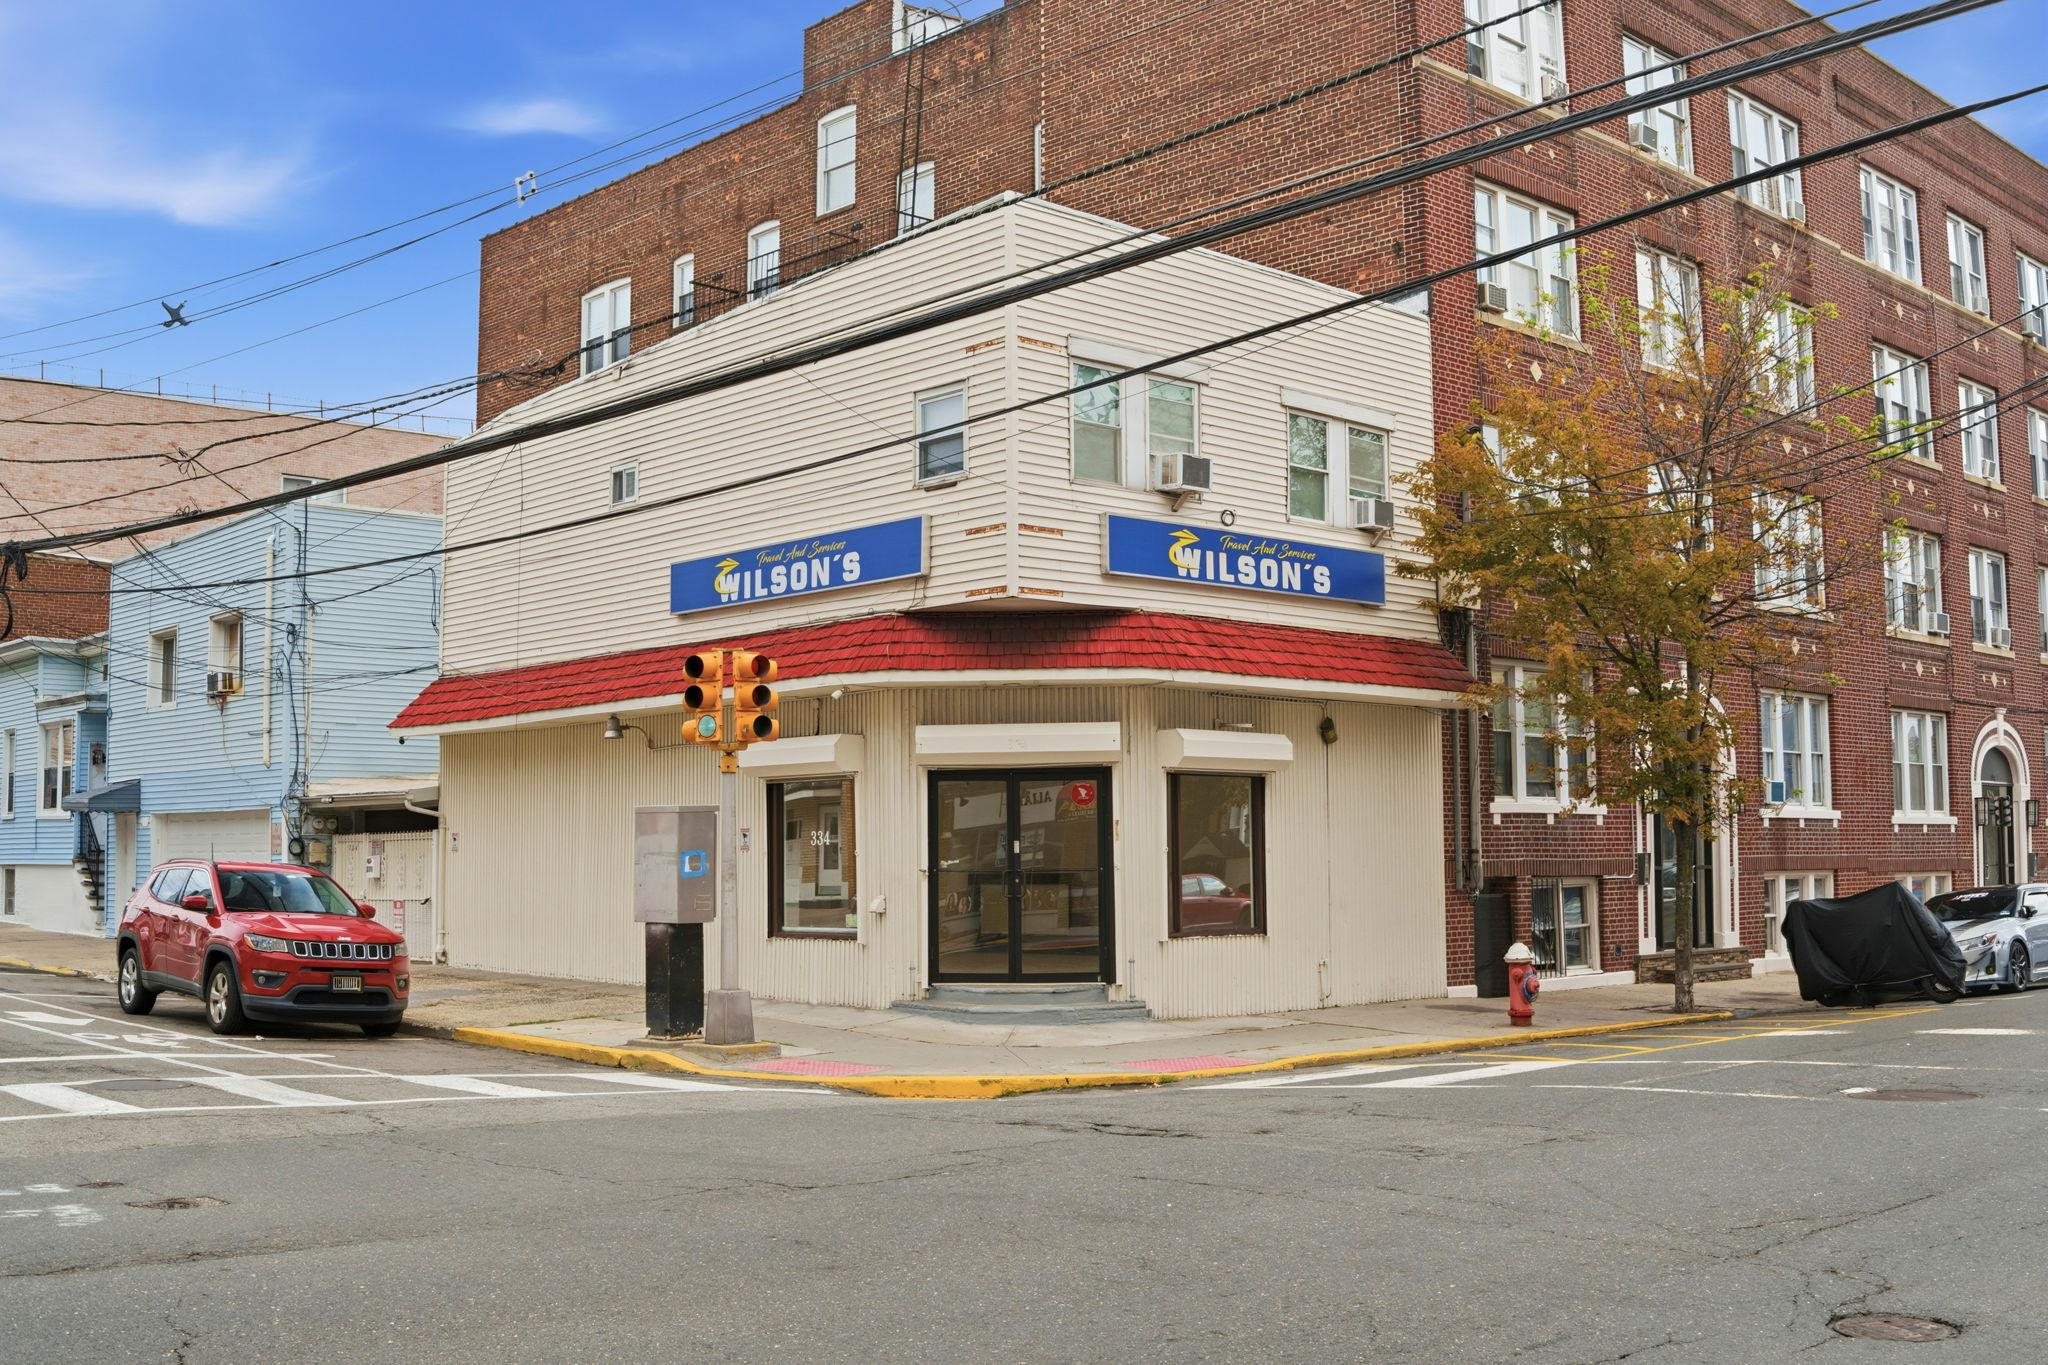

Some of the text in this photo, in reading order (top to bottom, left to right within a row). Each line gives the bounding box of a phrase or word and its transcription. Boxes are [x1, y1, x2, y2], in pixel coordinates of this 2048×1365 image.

[757, 541, 846, 566] Travel And Services
[1220, 535, 1316, 560] Travel And Services
[718, 551, 861, 602] WILSON'S
[1174, 547, 1332, 594] WILSON'S
[810, 830, 831, 846] 334
